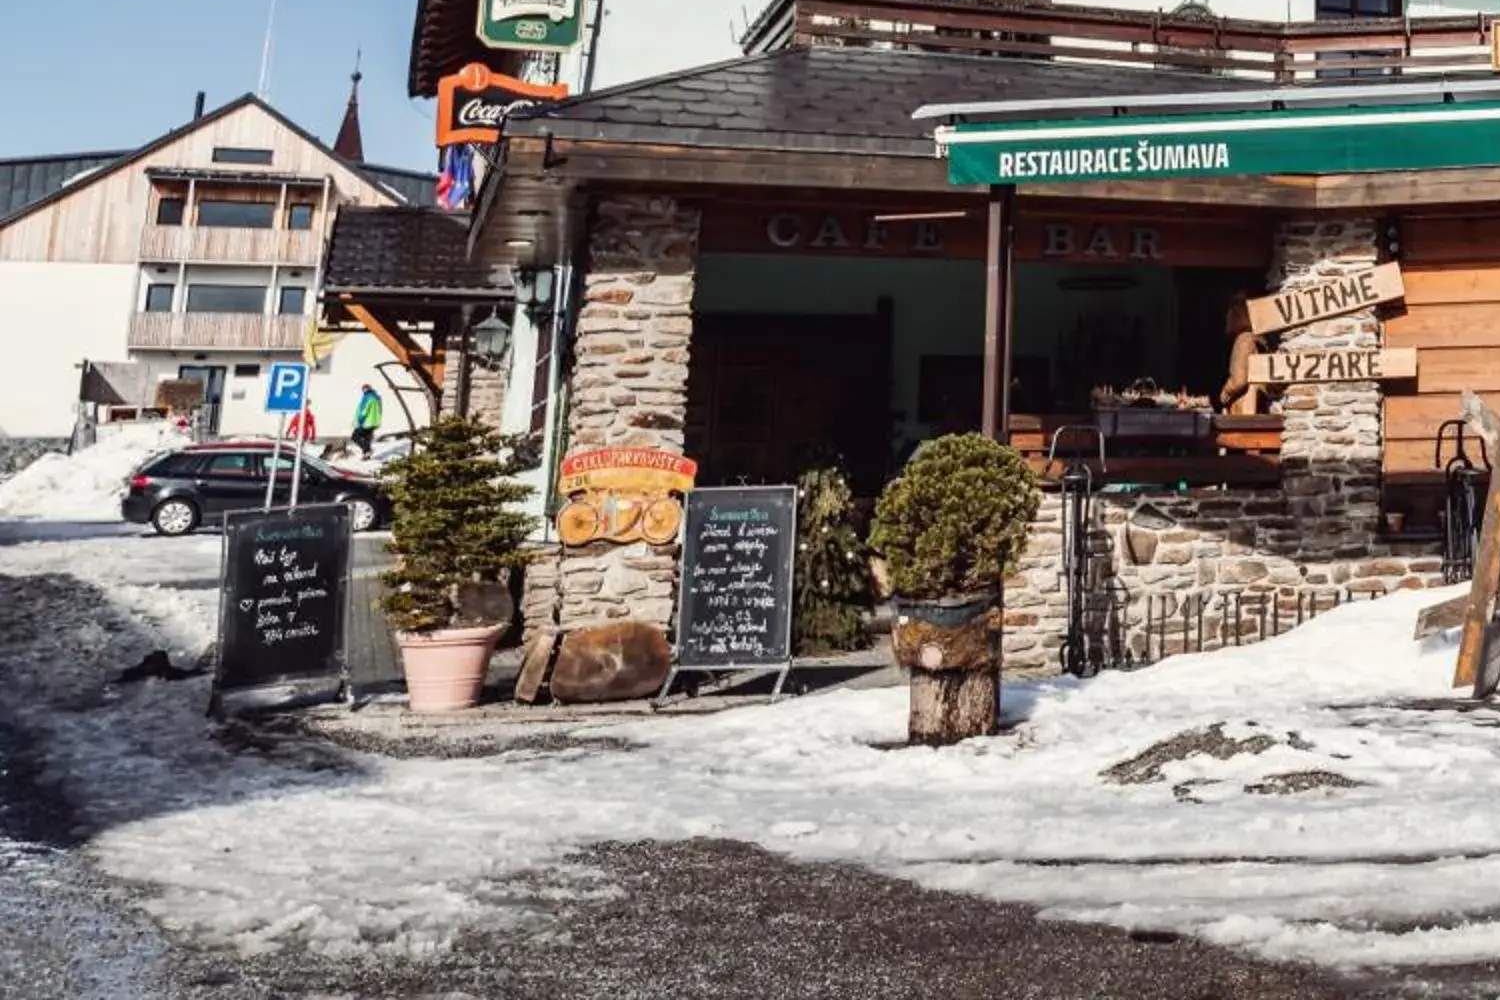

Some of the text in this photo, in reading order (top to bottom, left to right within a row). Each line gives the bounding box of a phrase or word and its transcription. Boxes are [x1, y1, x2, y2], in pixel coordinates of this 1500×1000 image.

[999, 141, 1230, 178] RESTAURACE ŠUMAVA
[1044, 223, 1164, 261] BAR
[275, 367, 301, 398] P
